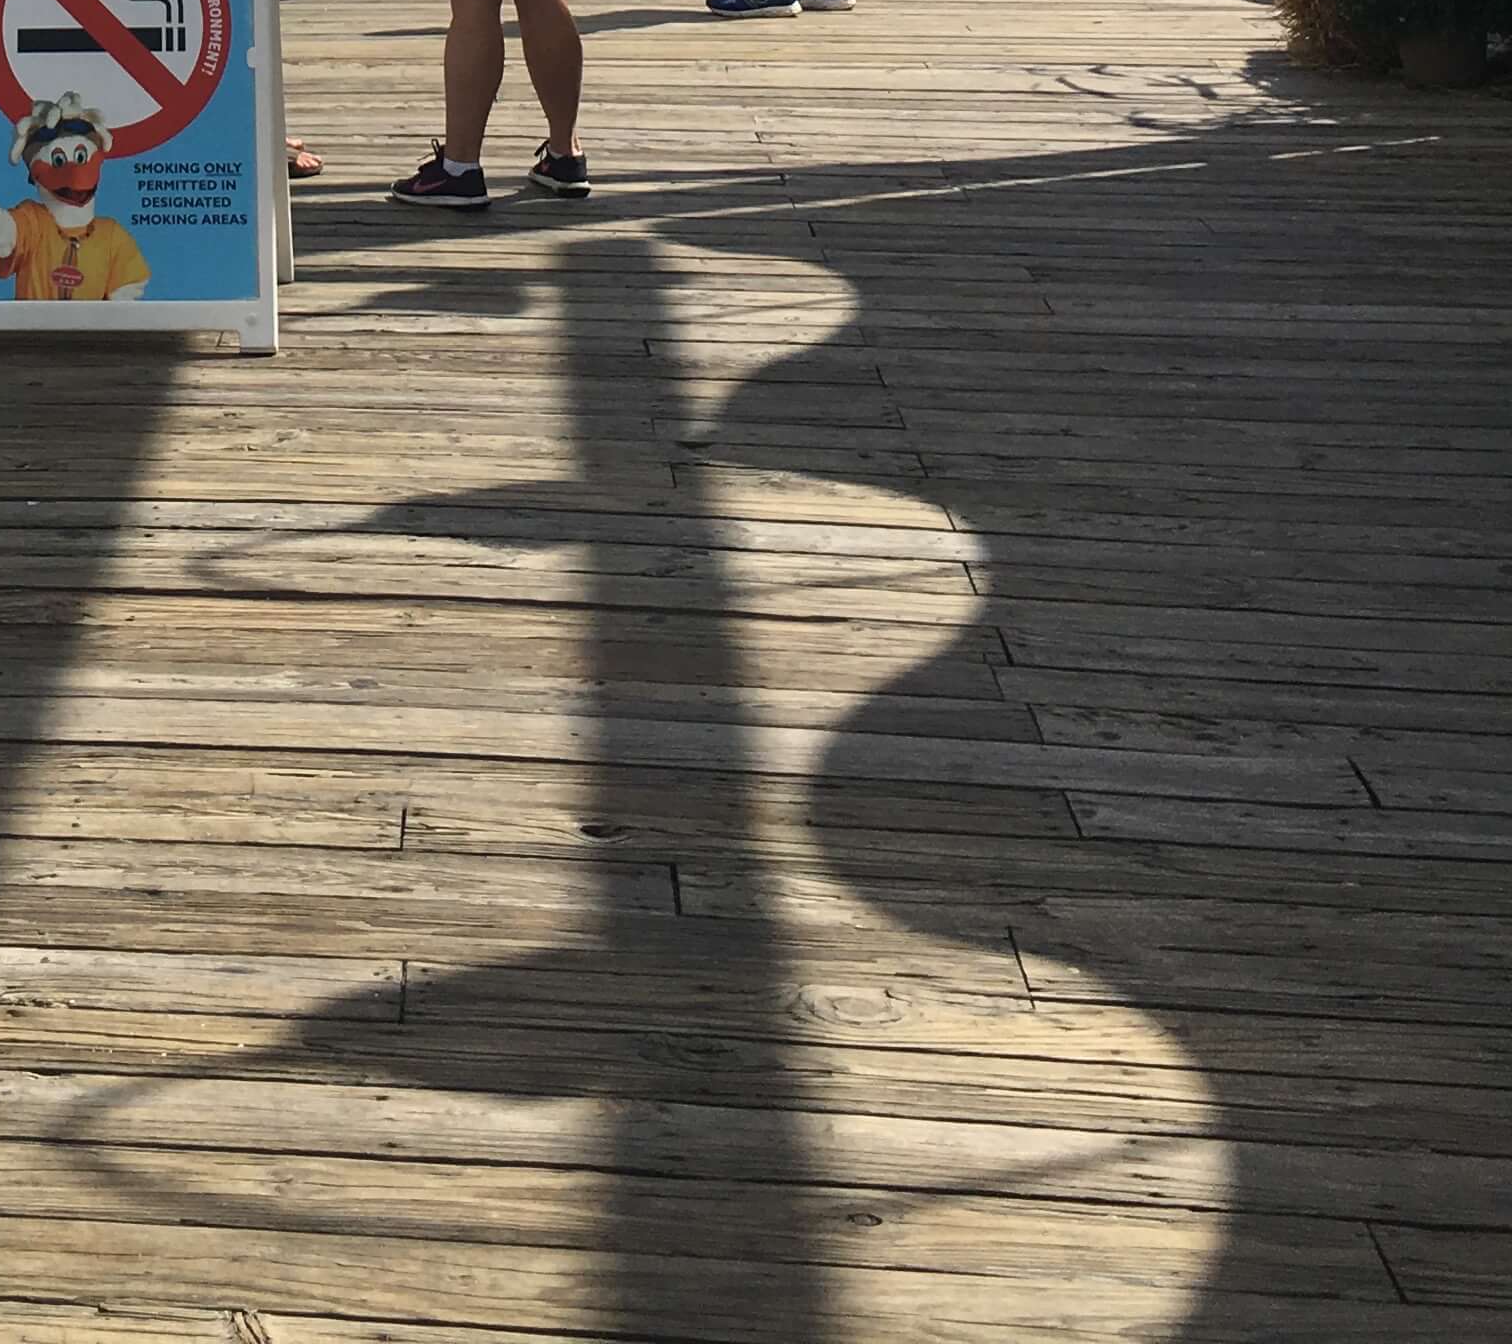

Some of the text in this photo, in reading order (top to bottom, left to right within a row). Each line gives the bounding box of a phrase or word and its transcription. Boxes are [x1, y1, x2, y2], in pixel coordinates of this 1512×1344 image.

[134, 162, 242, 176] SMOKING ONLY
[137, 179, 236, 191] PERMITTED IN
[141, 196, 232, 208] DESIGNATED
[131, 213, 248, 226] SMOKING AREAS
